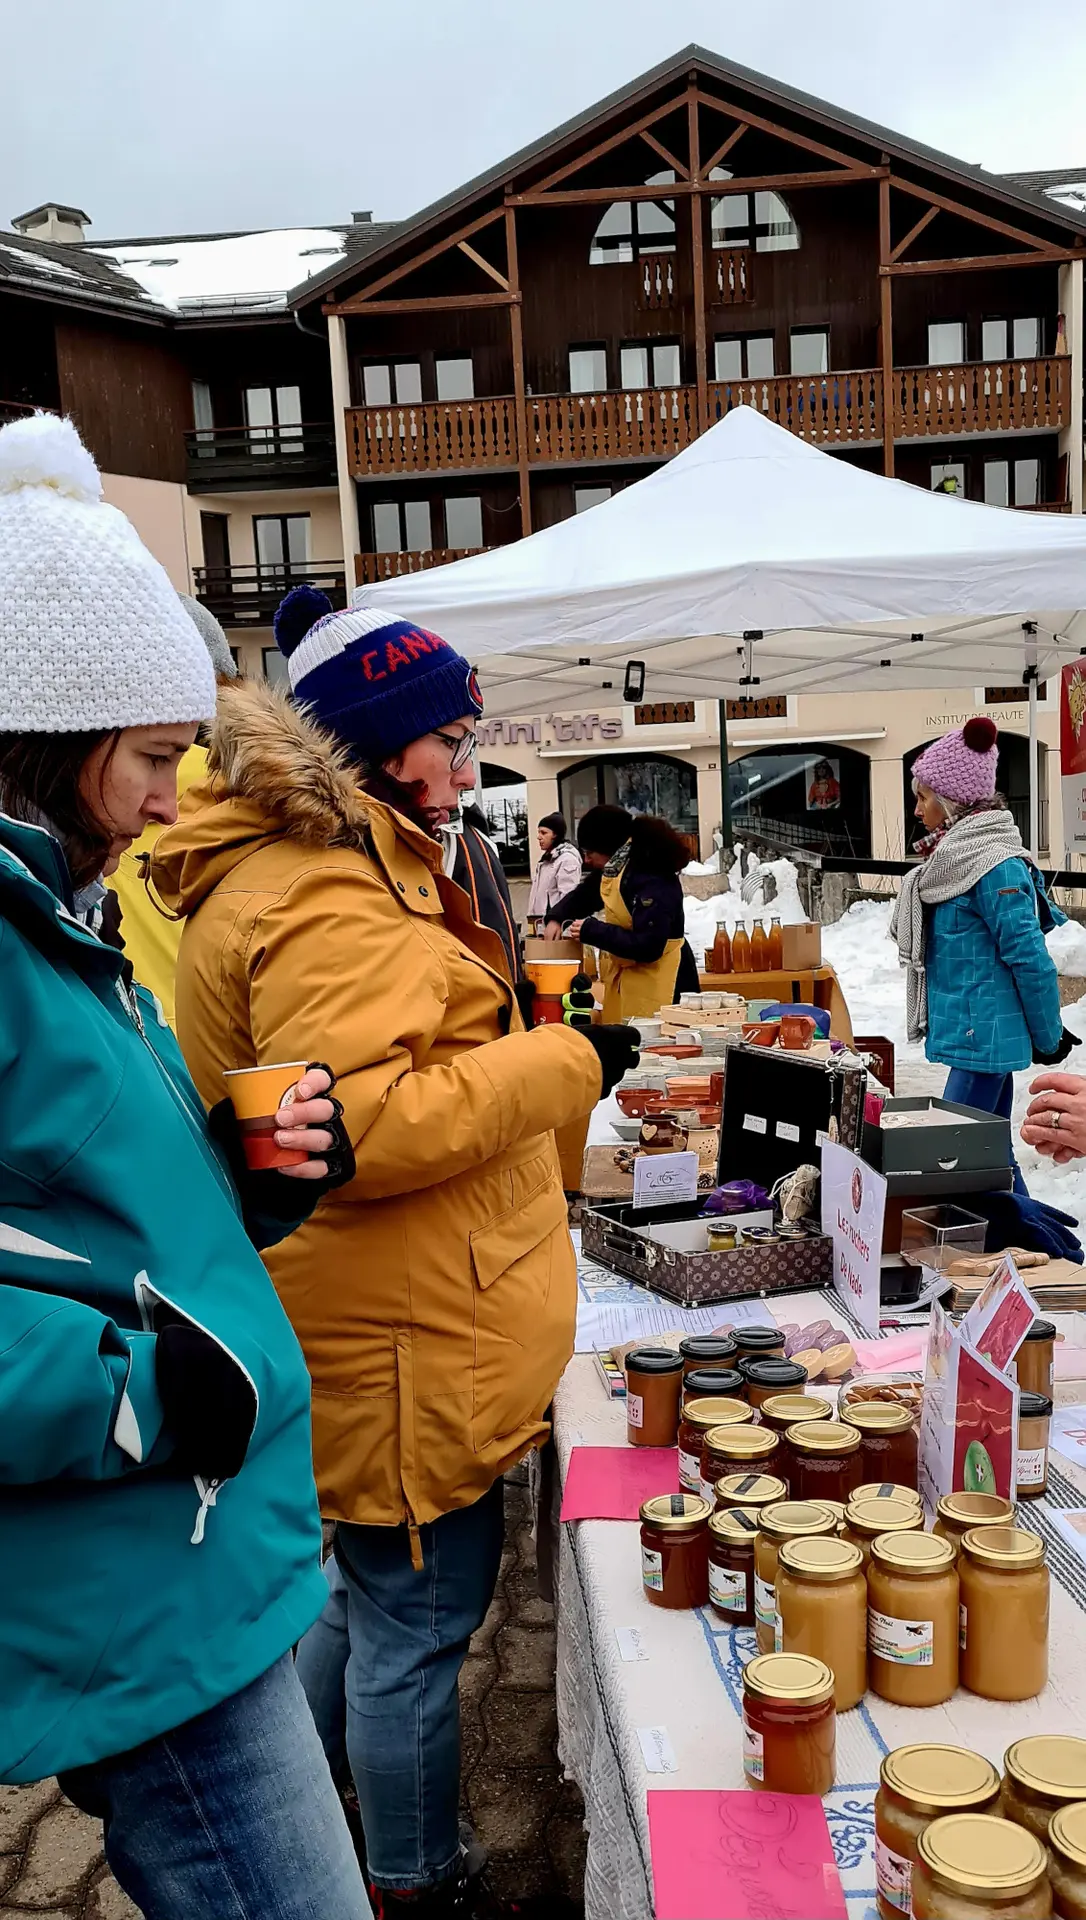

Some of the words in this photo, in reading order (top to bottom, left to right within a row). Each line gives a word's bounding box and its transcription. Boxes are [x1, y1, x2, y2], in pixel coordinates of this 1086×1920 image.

[926, 714, 969, 726] INSTITUT
[837, 1208, 849, 1234] Les
[849, 1226, 870, 1262] ruchers
[840, 1252, 847, 1278] De
